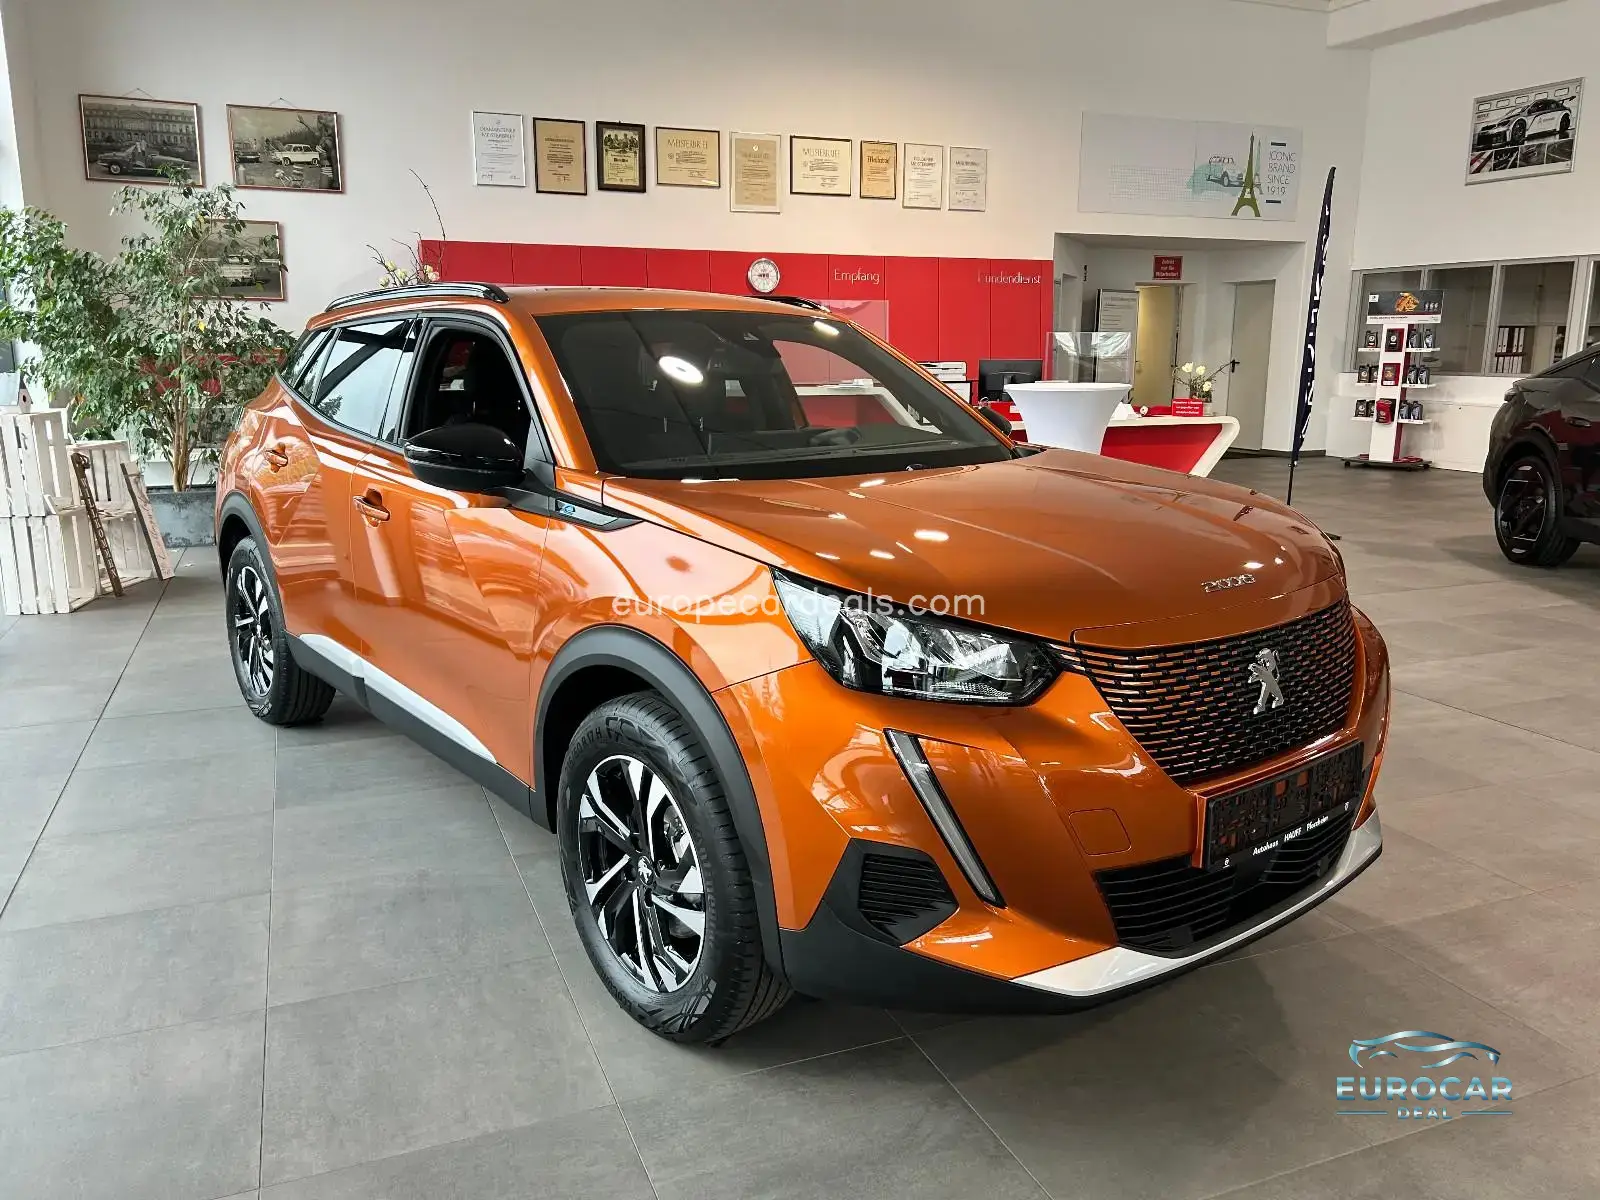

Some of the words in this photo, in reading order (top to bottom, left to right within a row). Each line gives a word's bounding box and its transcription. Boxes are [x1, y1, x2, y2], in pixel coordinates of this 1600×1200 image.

[1269, 150, 1297, 161] ICONIC
[1268, 162, 1296, 173] BRAND
[1267, 174, 1290, 185] SINCE
[834, 267, 880, 285] Empfang
[1201, 573, 1256, 593] 2008
